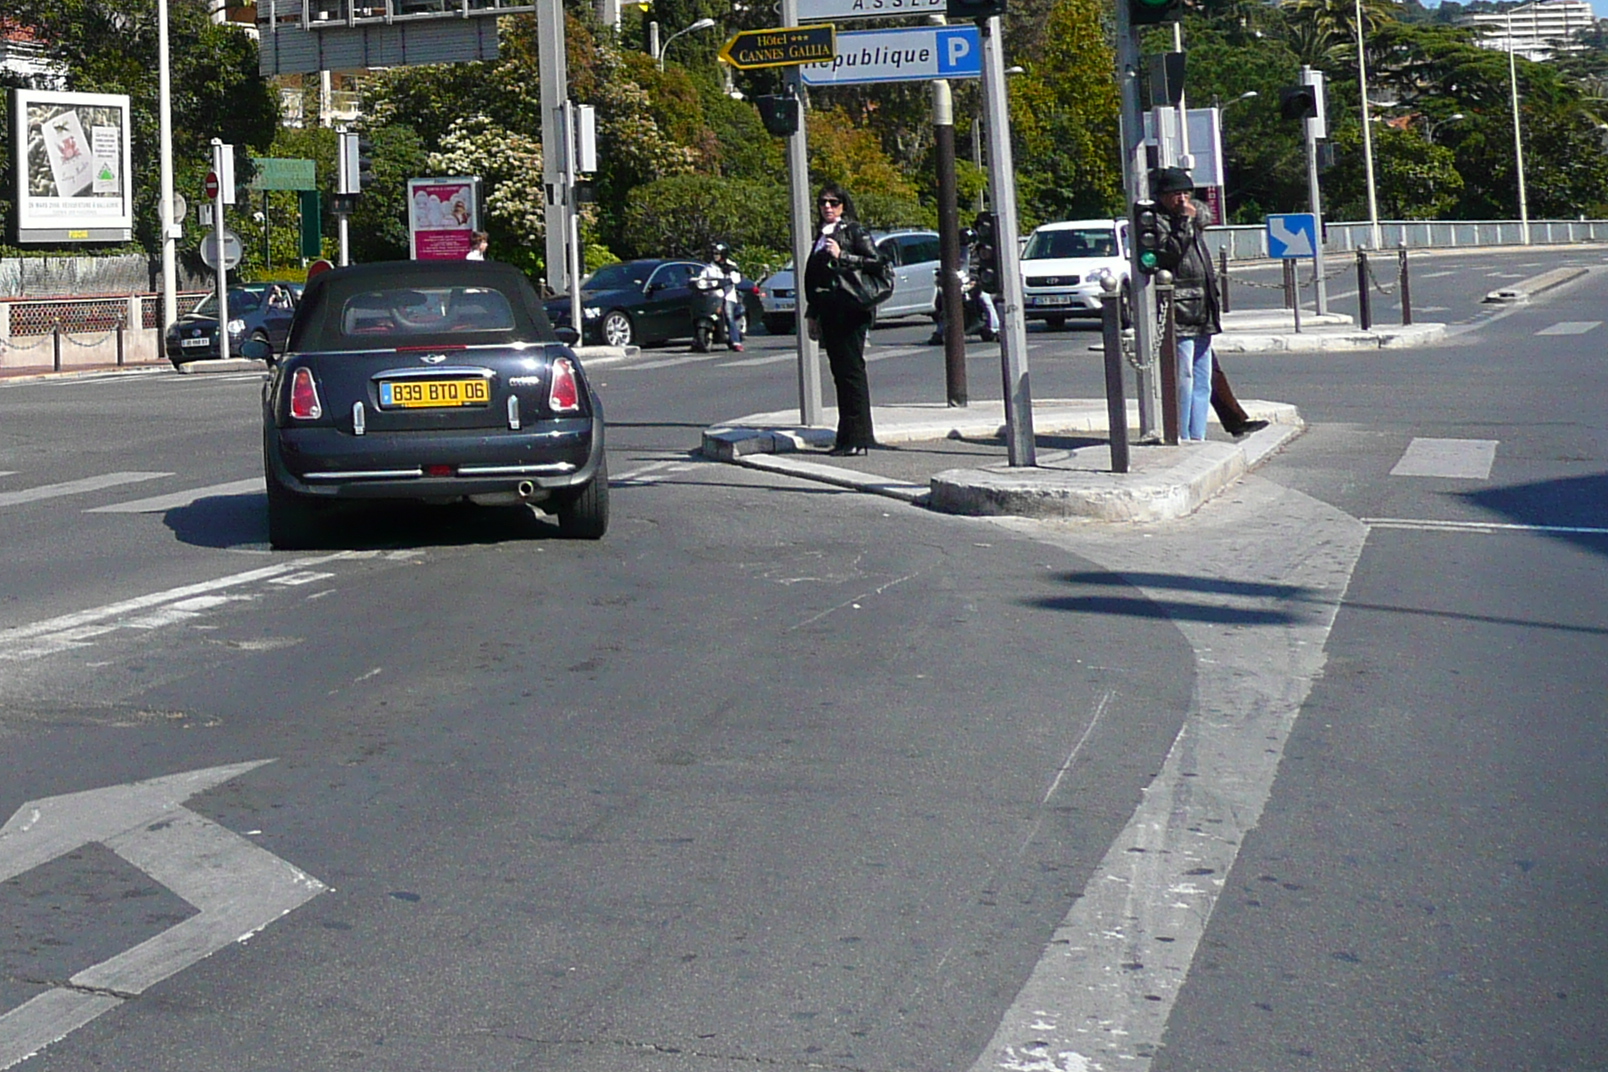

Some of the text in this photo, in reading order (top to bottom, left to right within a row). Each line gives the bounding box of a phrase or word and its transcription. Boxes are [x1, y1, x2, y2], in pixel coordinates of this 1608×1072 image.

[757, 34, 787, 47] Hôtel
[739, 44, 830, 62] CANNES GALLIA
[393, 382, 484, 401] 839 BTQ 06
